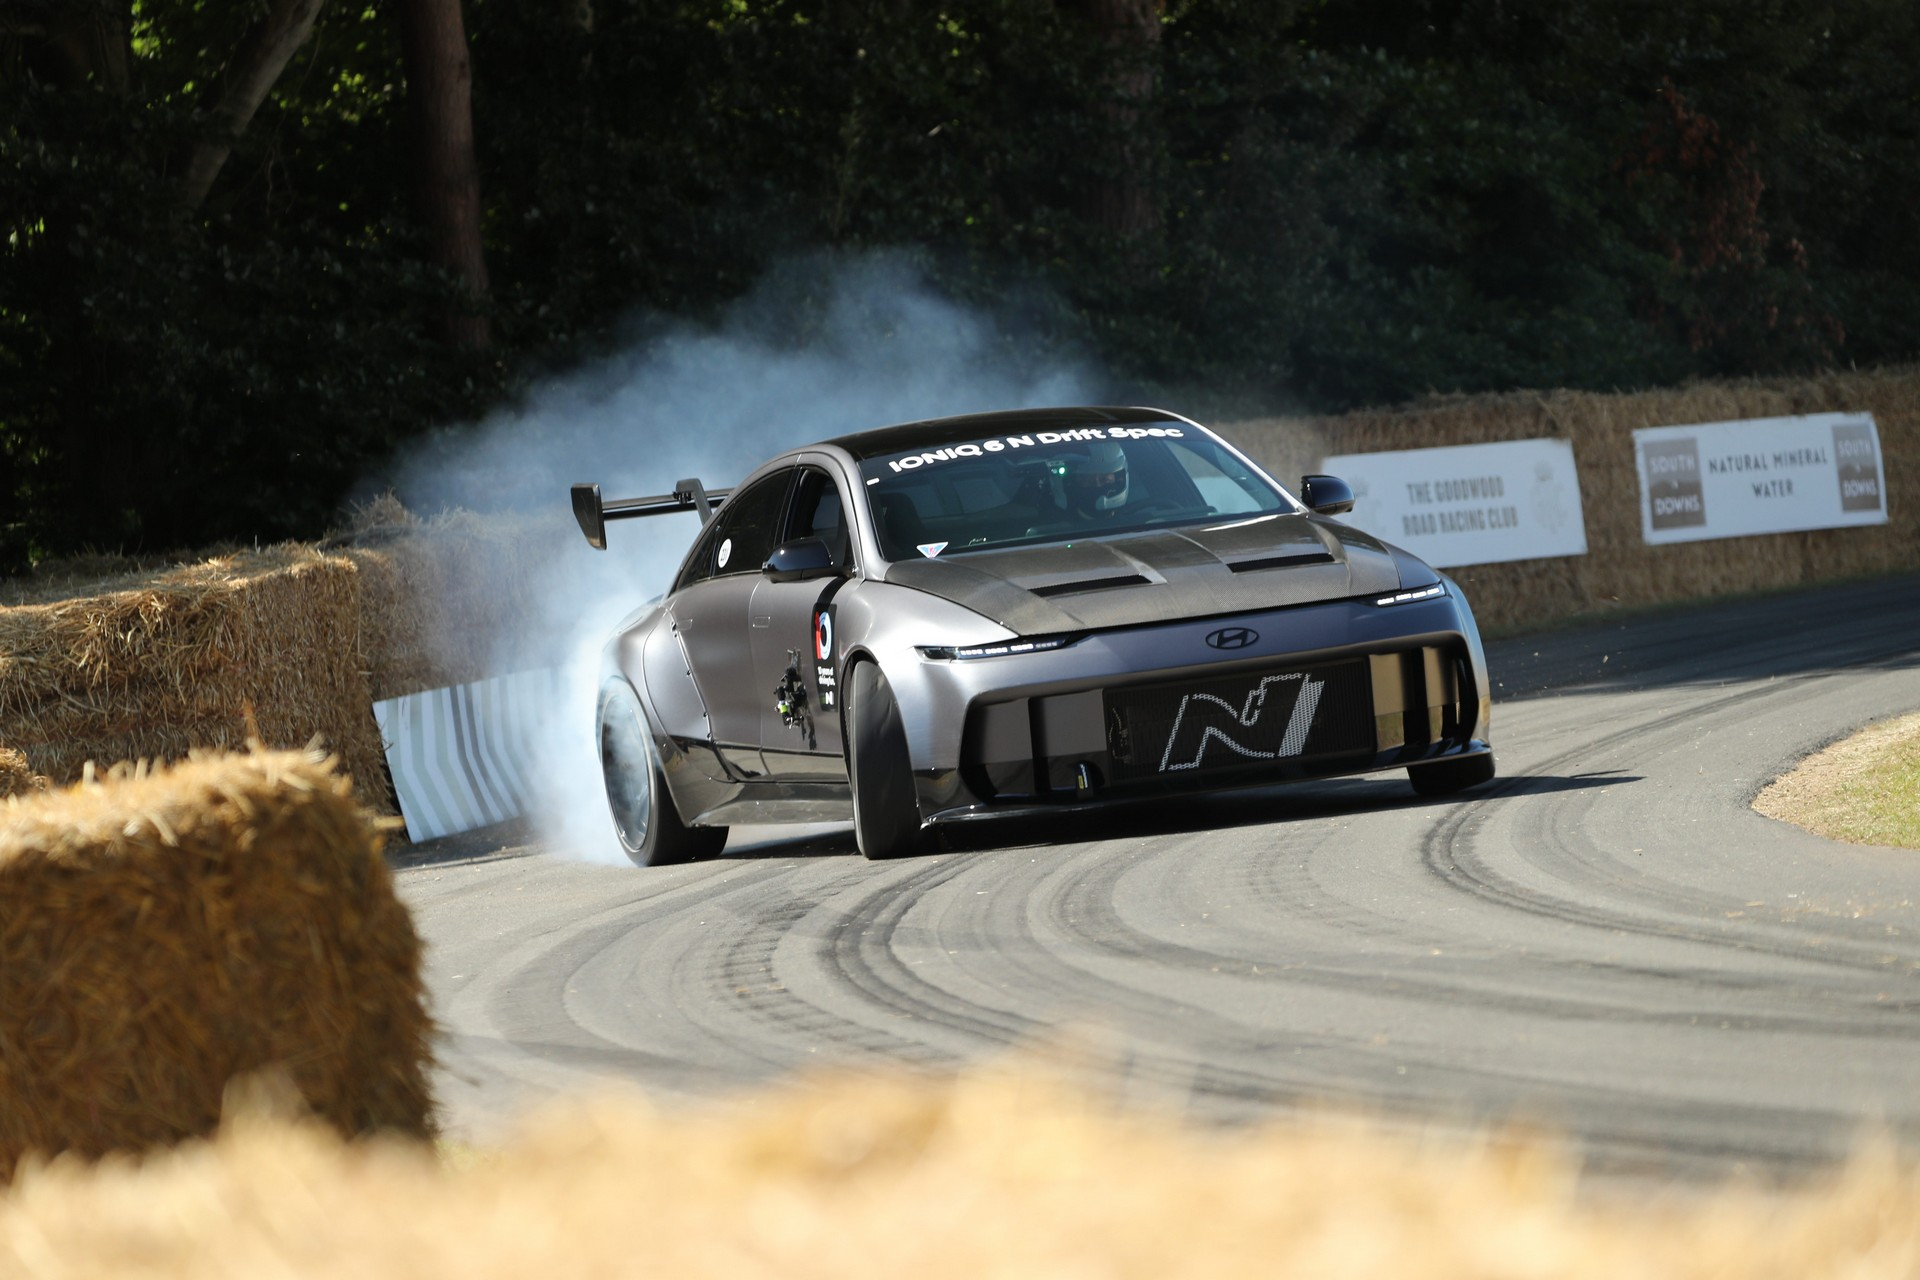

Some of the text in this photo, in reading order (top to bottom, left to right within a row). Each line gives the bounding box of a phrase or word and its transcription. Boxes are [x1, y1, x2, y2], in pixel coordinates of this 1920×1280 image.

[888, 427, 1184, 472] IONIQ 6 N Drift Spec
[1709, 446, 1828, 475] NATURAL MINERAL
[1650, 453, 1695, 473] SOUTH
[1406, 476, 1505, 505] THE GOODWOOD
[1752, 479, 1795, 499] WATER
[1844, 479, 1877, 497] DOWNS
[1655, 494, 1701, 515] DOWNS
[1402, 506, 1519, 538] ROAD RACING CLUB
